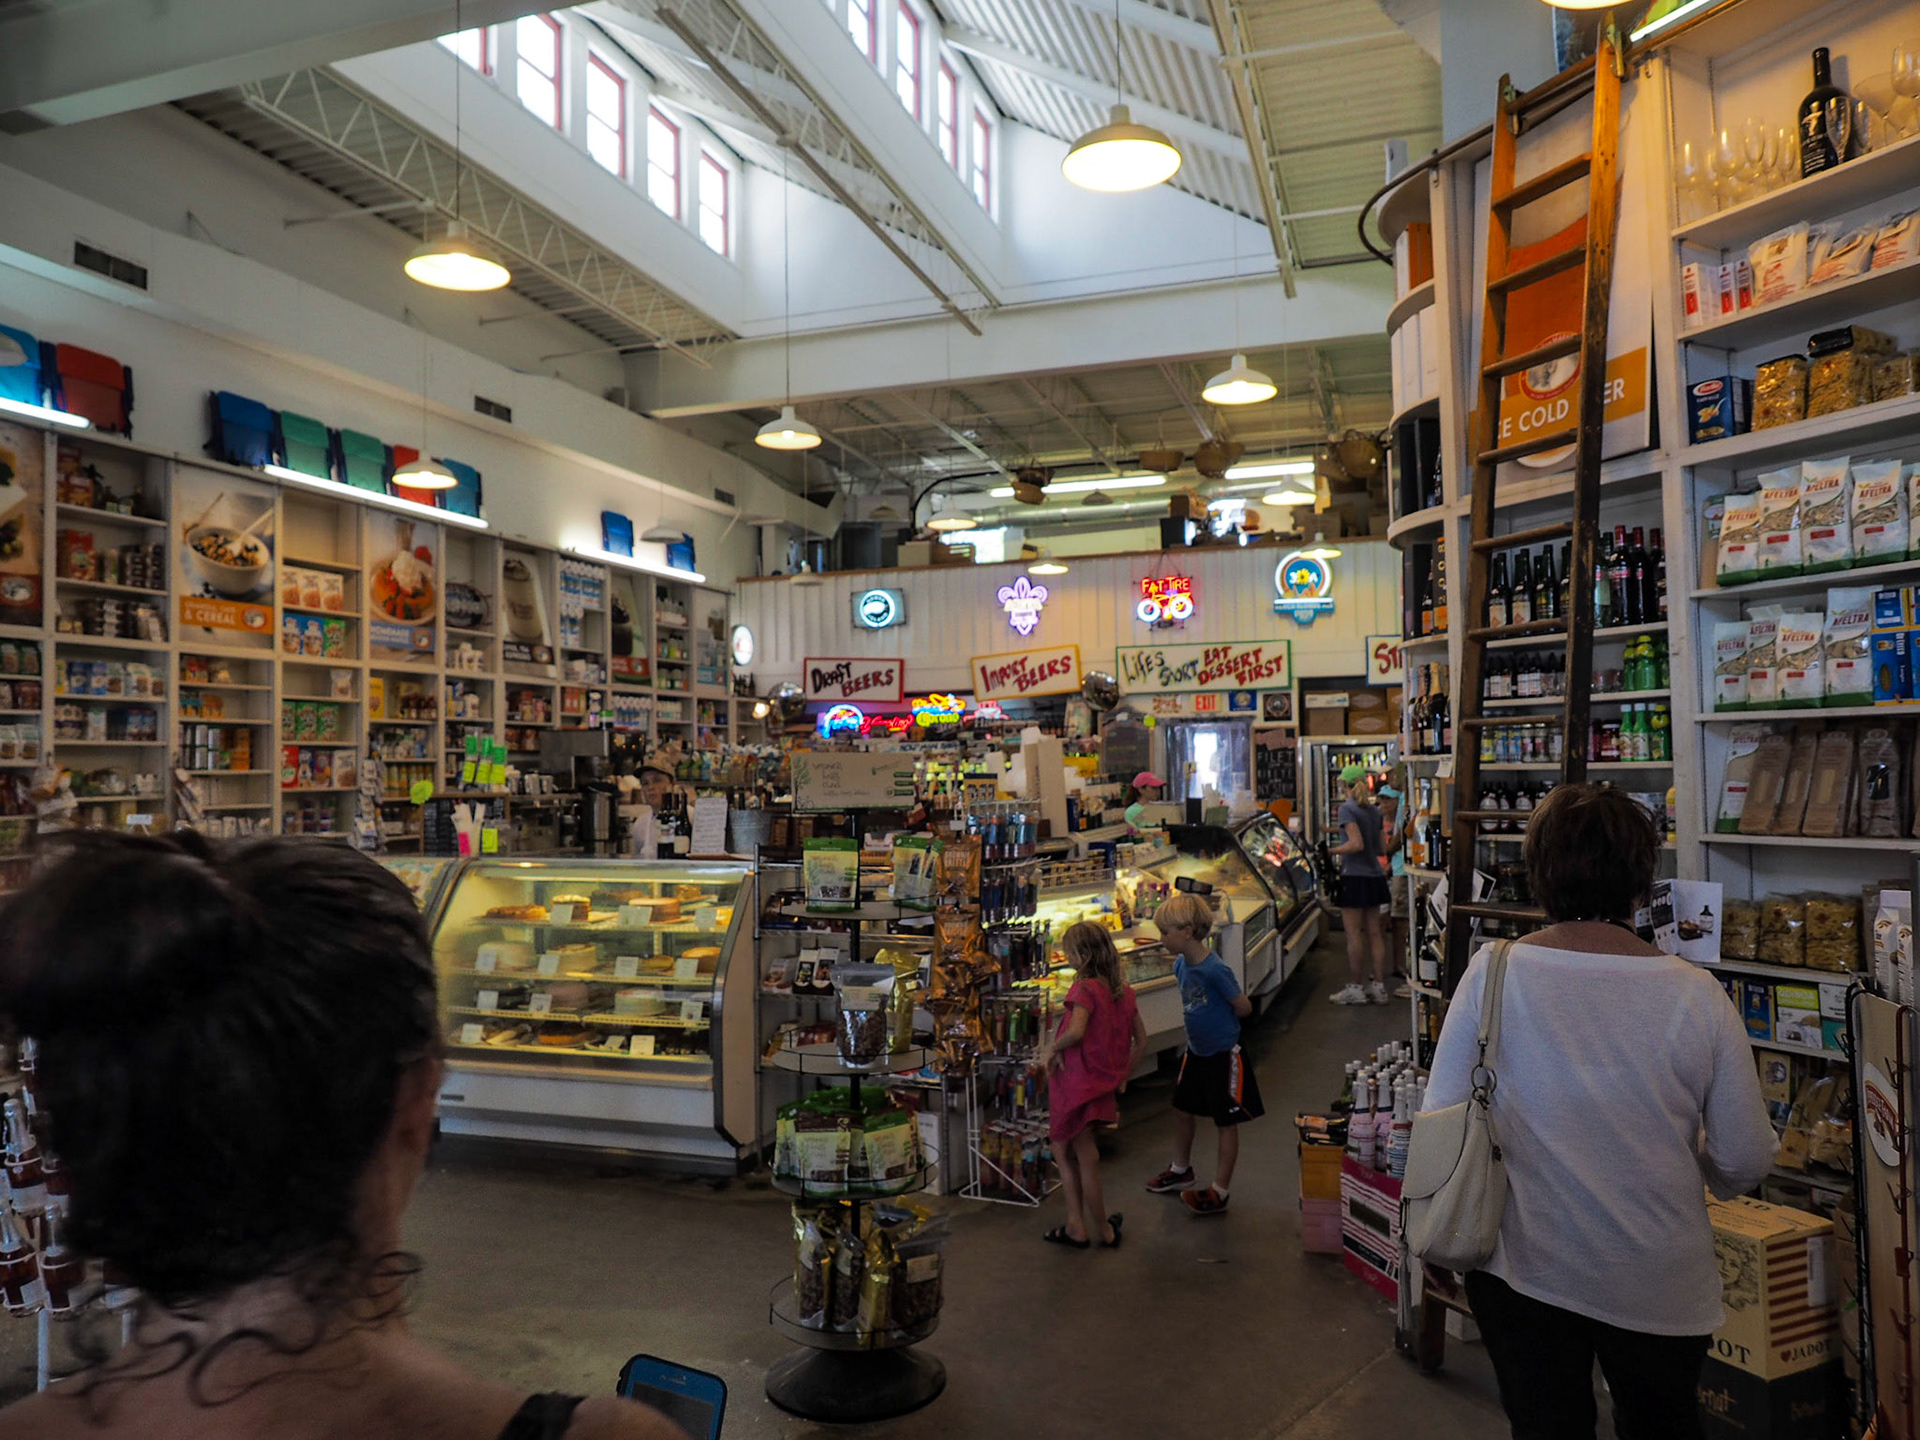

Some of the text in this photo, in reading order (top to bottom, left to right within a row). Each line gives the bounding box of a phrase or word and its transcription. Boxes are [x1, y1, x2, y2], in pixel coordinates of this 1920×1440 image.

[1518, 398, 1569, 432] COLD
[1603, 378, 1625, 405] ER
[1763, 487, 1799, 501] AFELTRA
[1805, 477, 1840, 493] AFELTRA
[1859, 484, 1893, 499] AFELTRA
[1141, 576, 1190, 595] FAT TIRE
[195, 609, 236, 626] CEREAL
[1832, 612, 1870, 627] AFELTRA
[1781, 632, 1815, 643] AFELTRA
[1203, 646, 1232, 667] EAT
[1012, 655, 1072, 693] BEERS
[1197, 647, 1262, 686] DESSERT
[1235, 655, 1283, 687] FIRST
[841, 668, 894, 698] BEERS
[1195, 694, 1216, 712] EXIT
[915, 711, 960, 728] Corona
[1791, 1339, 1832, 1361] JADOT
